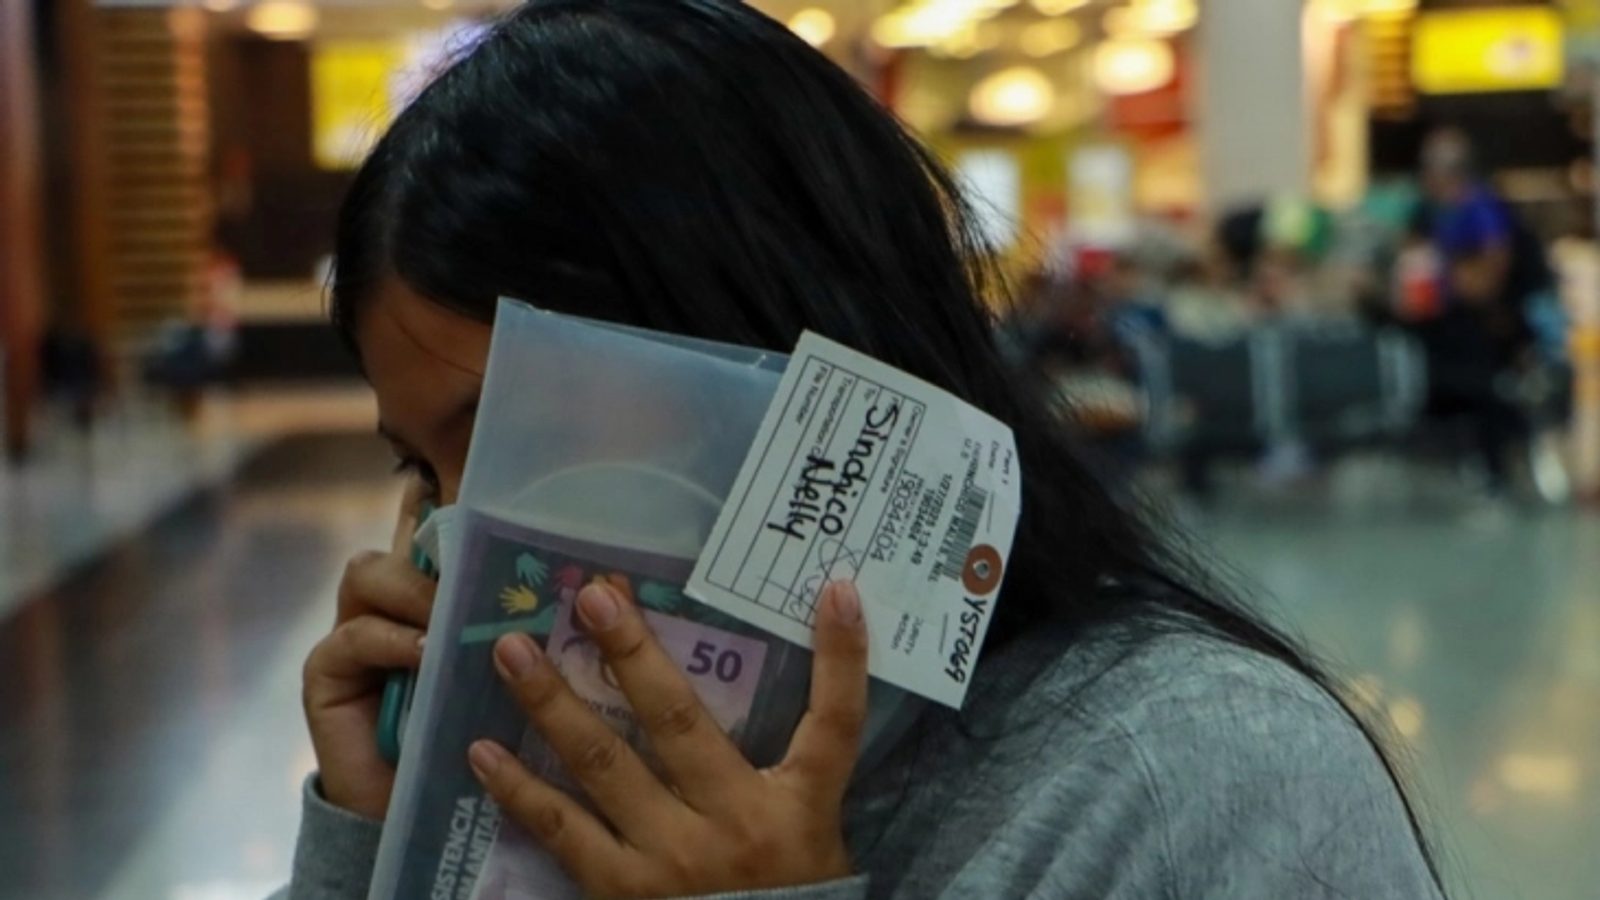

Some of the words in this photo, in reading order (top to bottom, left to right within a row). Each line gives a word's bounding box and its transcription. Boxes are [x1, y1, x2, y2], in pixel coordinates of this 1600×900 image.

[812, 365, 827, 384] File
[794, 385, 818, 424] Number
[766, 455, 834, 541] Nelly
[868, 468, 919, 563] 19034404
[686, 641, 743, 684] 50
